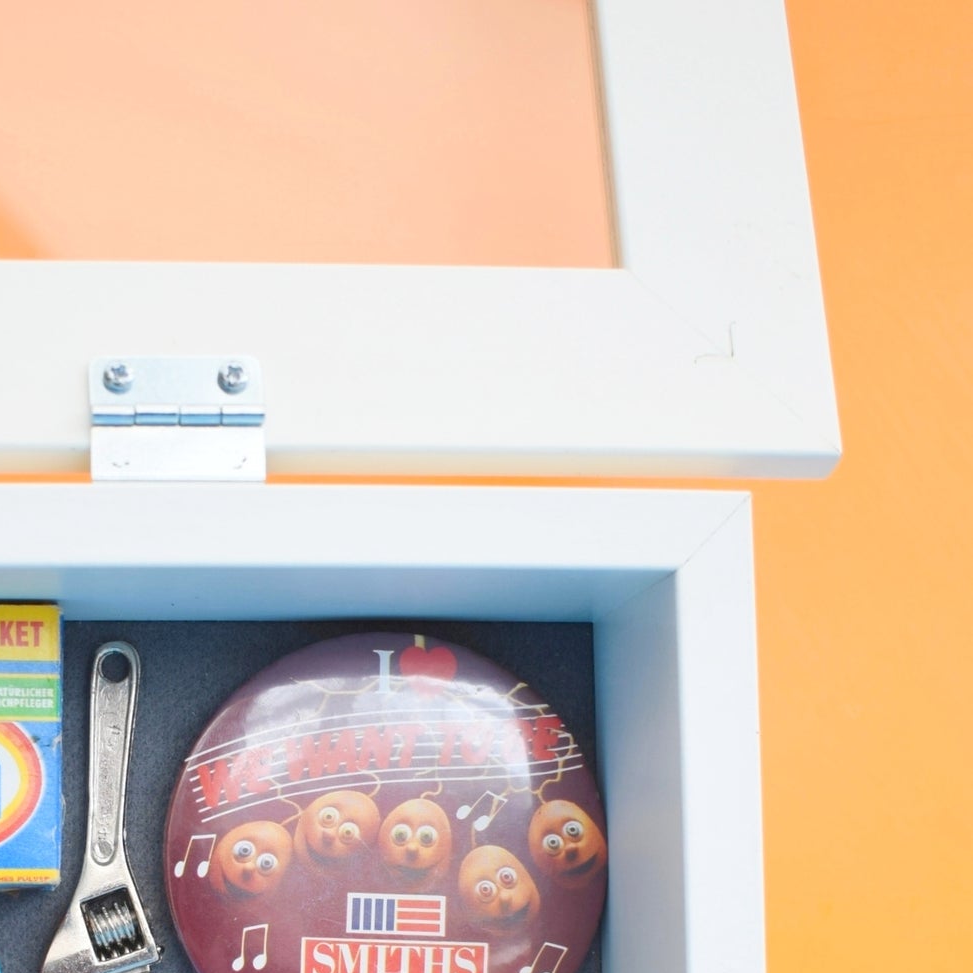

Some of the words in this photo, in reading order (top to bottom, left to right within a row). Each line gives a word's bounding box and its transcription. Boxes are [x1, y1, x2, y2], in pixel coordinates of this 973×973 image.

[373, 650, 395, 694] I
[197, 747, 272, 808] WE
[284, 724, 424, 781] WANT
